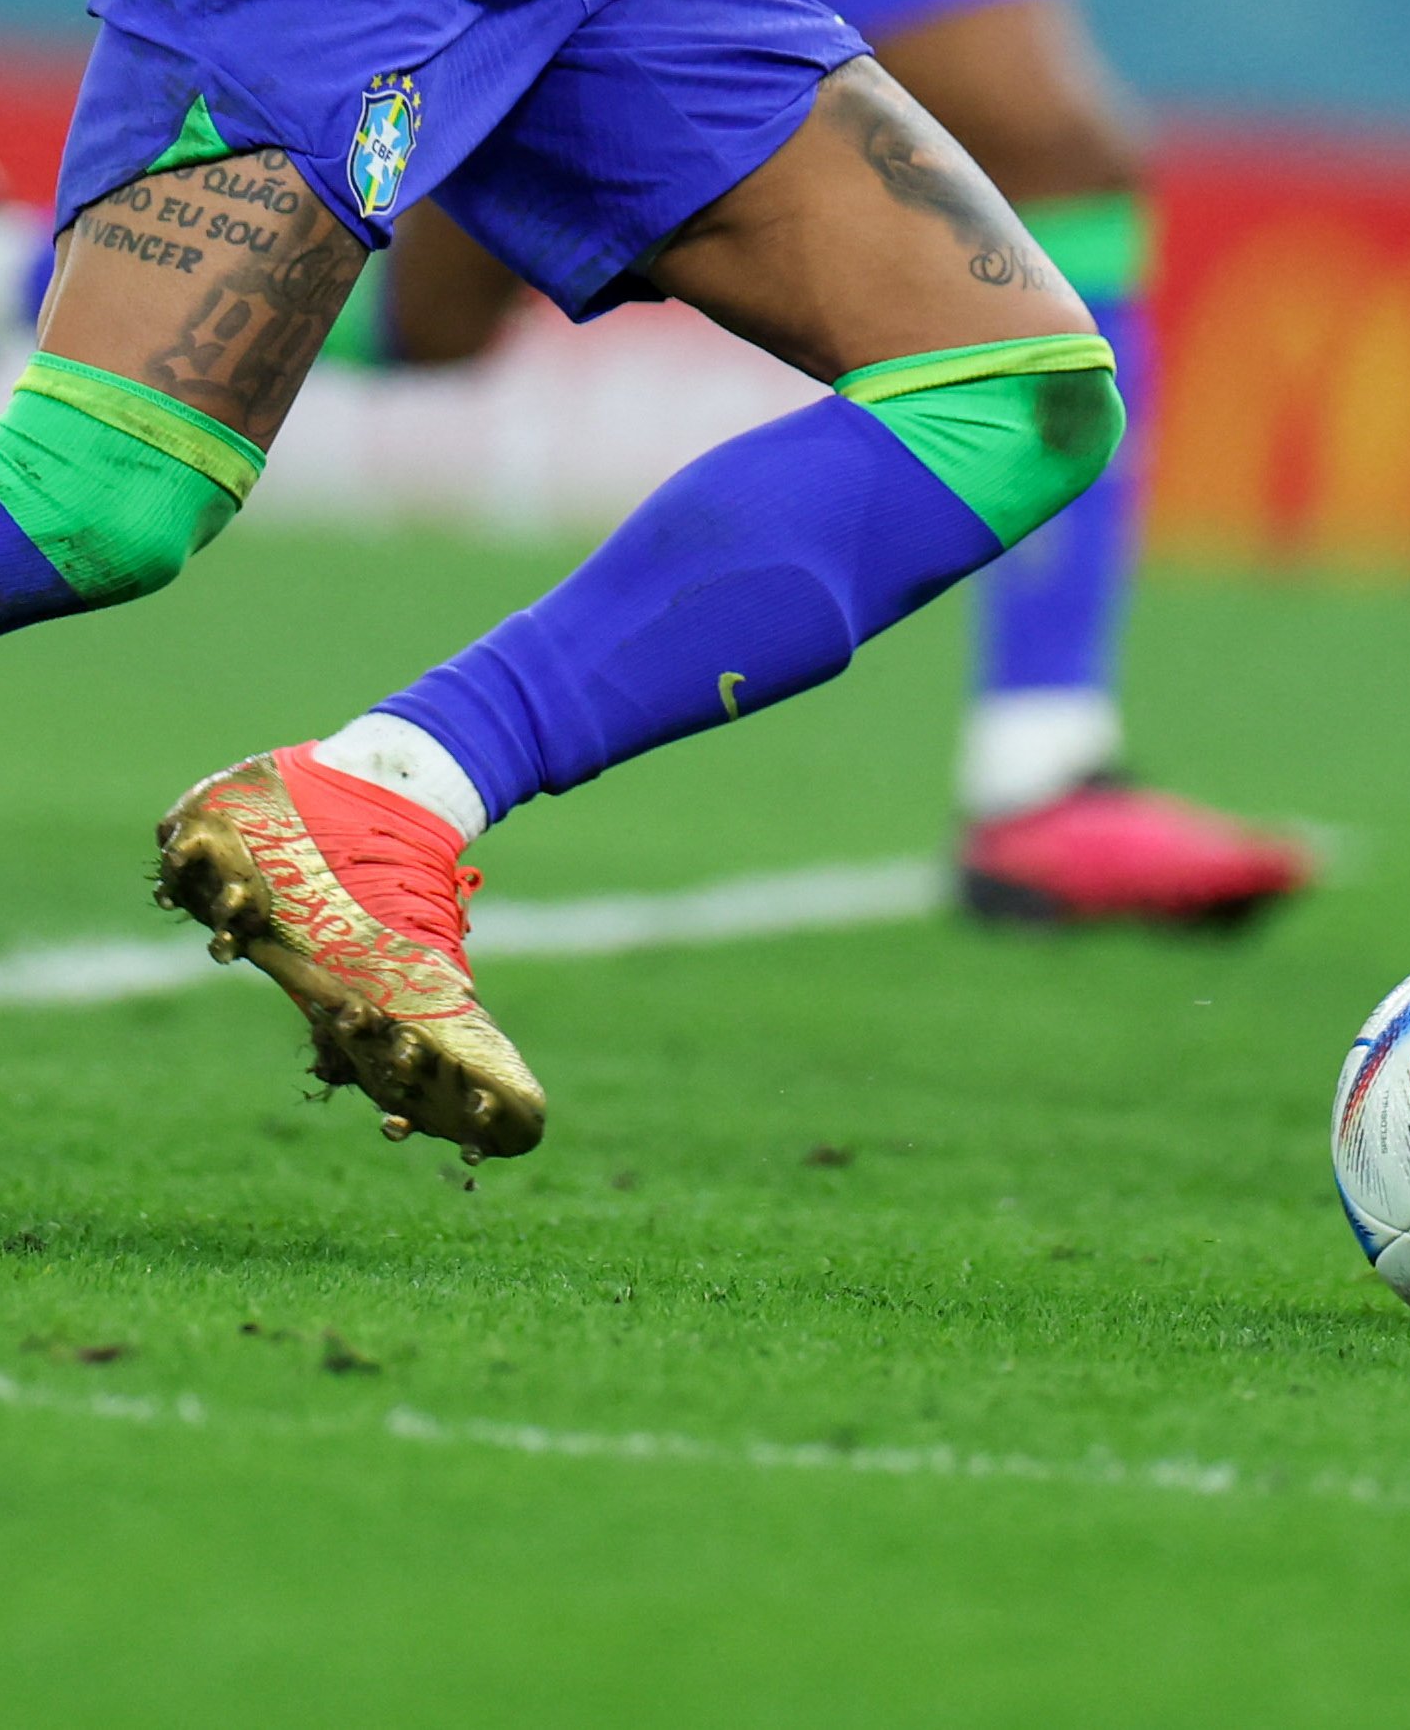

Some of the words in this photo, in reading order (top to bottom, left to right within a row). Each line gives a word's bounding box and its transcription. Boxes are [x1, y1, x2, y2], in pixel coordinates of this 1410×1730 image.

[372, 139, 393, 162] CBF
[203, 166, 300, 214] QUÃO
[93, 220, 204, 274] VENCER
[157, 196, 205, 228] EU
[206, 212, 280, 254] SOU
